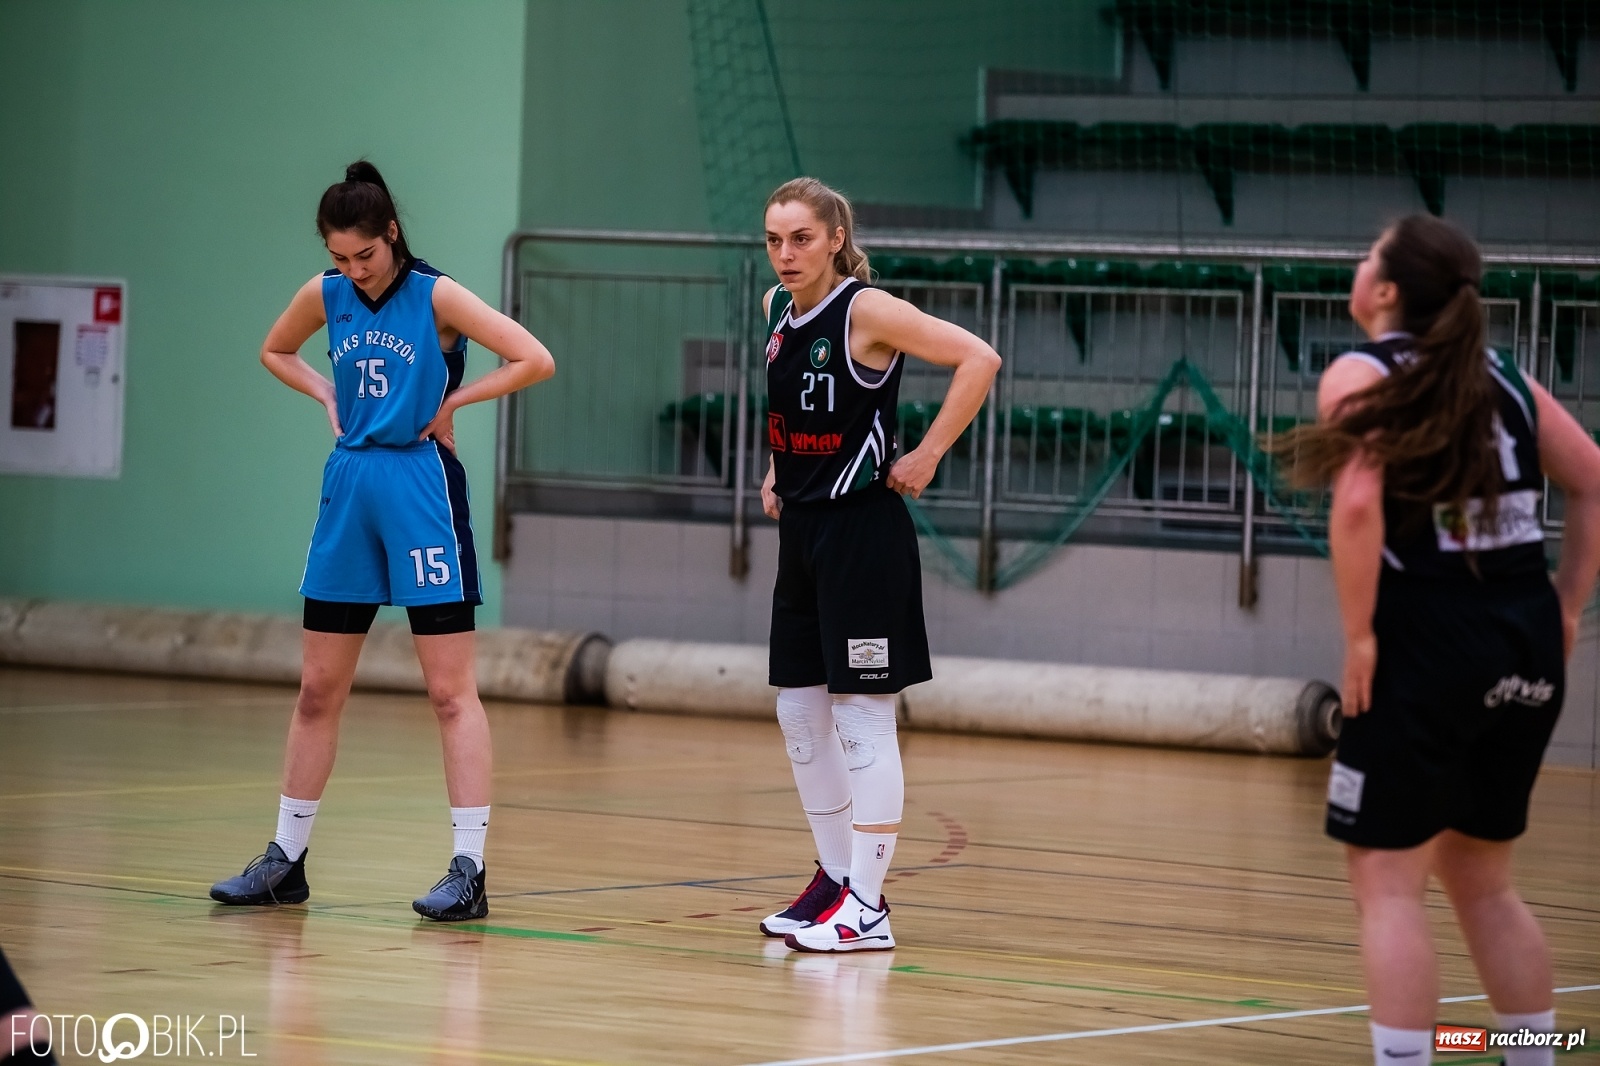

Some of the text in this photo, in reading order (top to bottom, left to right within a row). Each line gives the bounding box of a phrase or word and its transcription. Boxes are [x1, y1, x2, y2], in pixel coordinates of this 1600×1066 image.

[335, 313, 353, 324] UFO
[355, 358, 390, 399] 15
[801, 372, 834, 411] 27
[408, 545, 451, 588] 15
